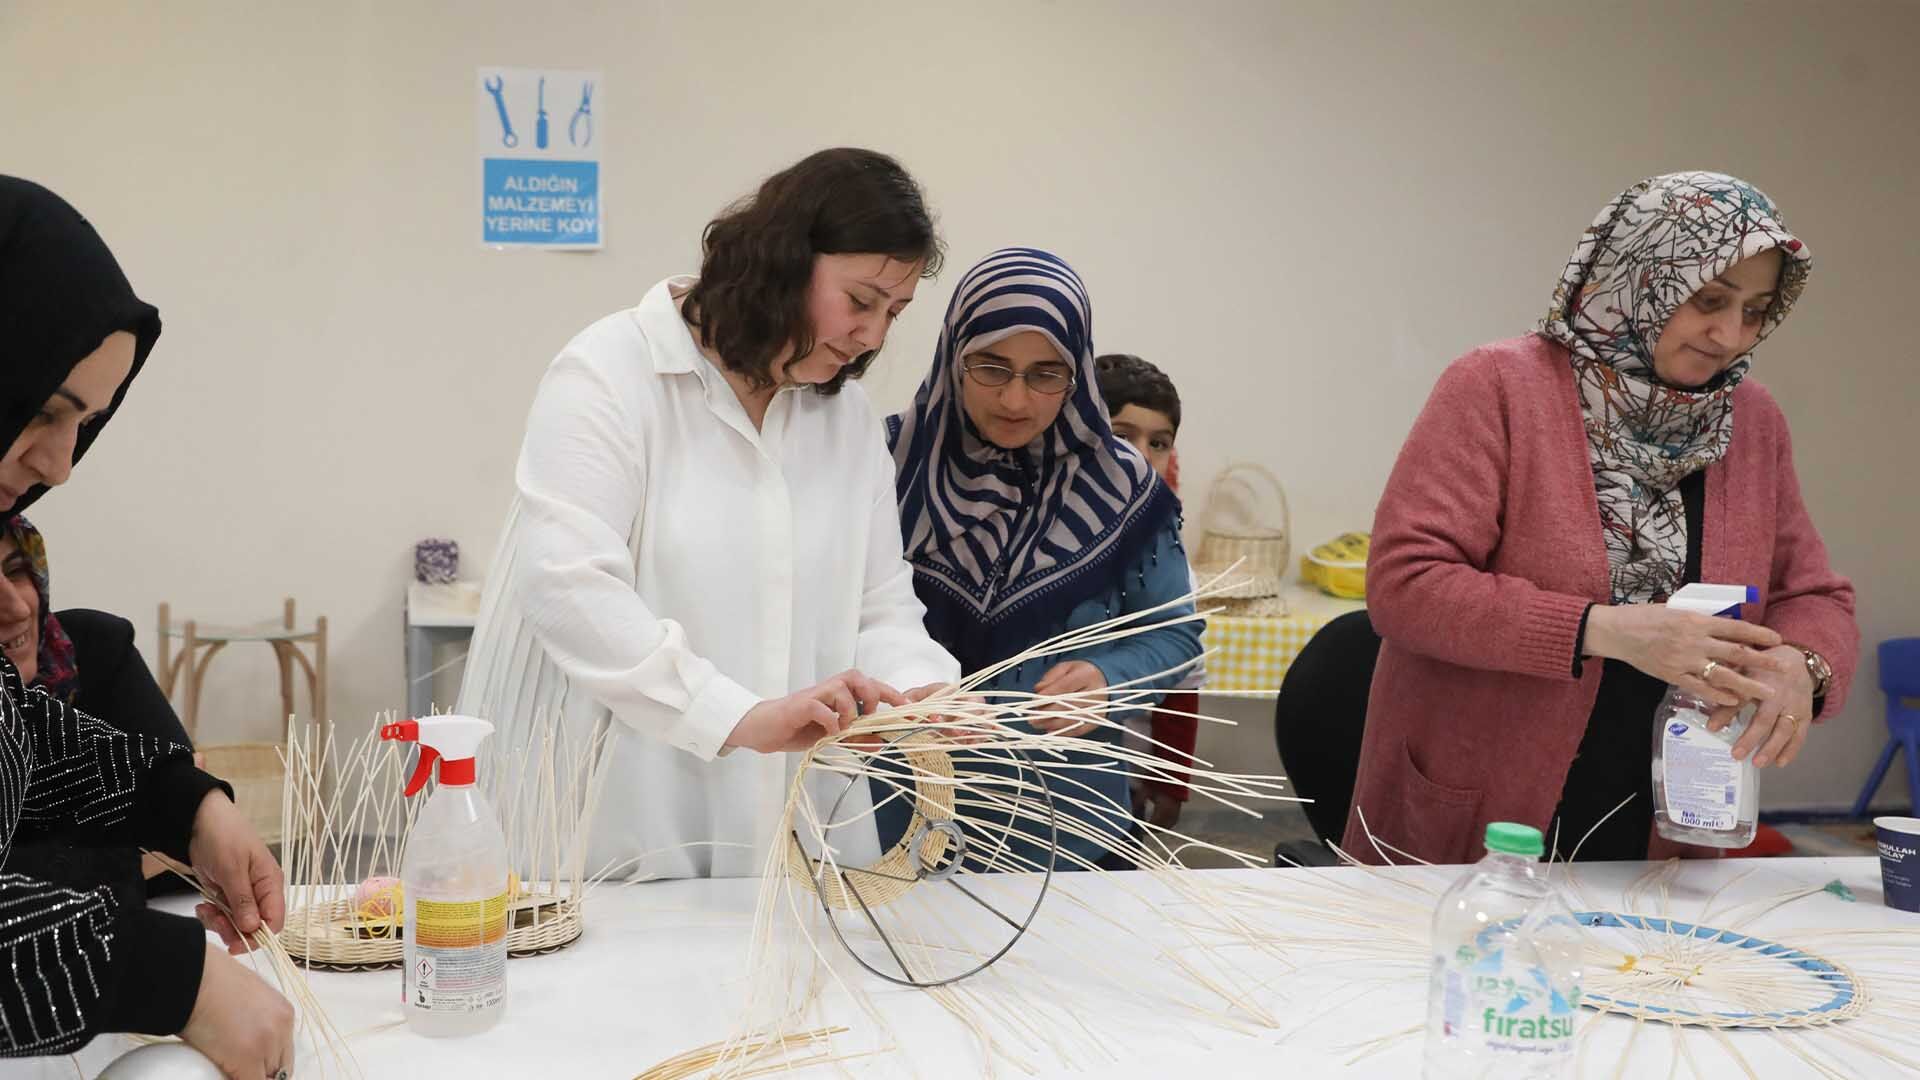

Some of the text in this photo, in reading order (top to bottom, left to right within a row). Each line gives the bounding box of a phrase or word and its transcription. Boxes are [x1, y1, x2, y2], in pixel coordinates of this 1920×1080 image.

[503, 174, 578, 193] ALDIĞIN
[487, 195, 593, 213] MALZEMEYİ
[487, 213, 595, 234] YERİNE KOY
[1680, 816, 1701, 826] 1000
